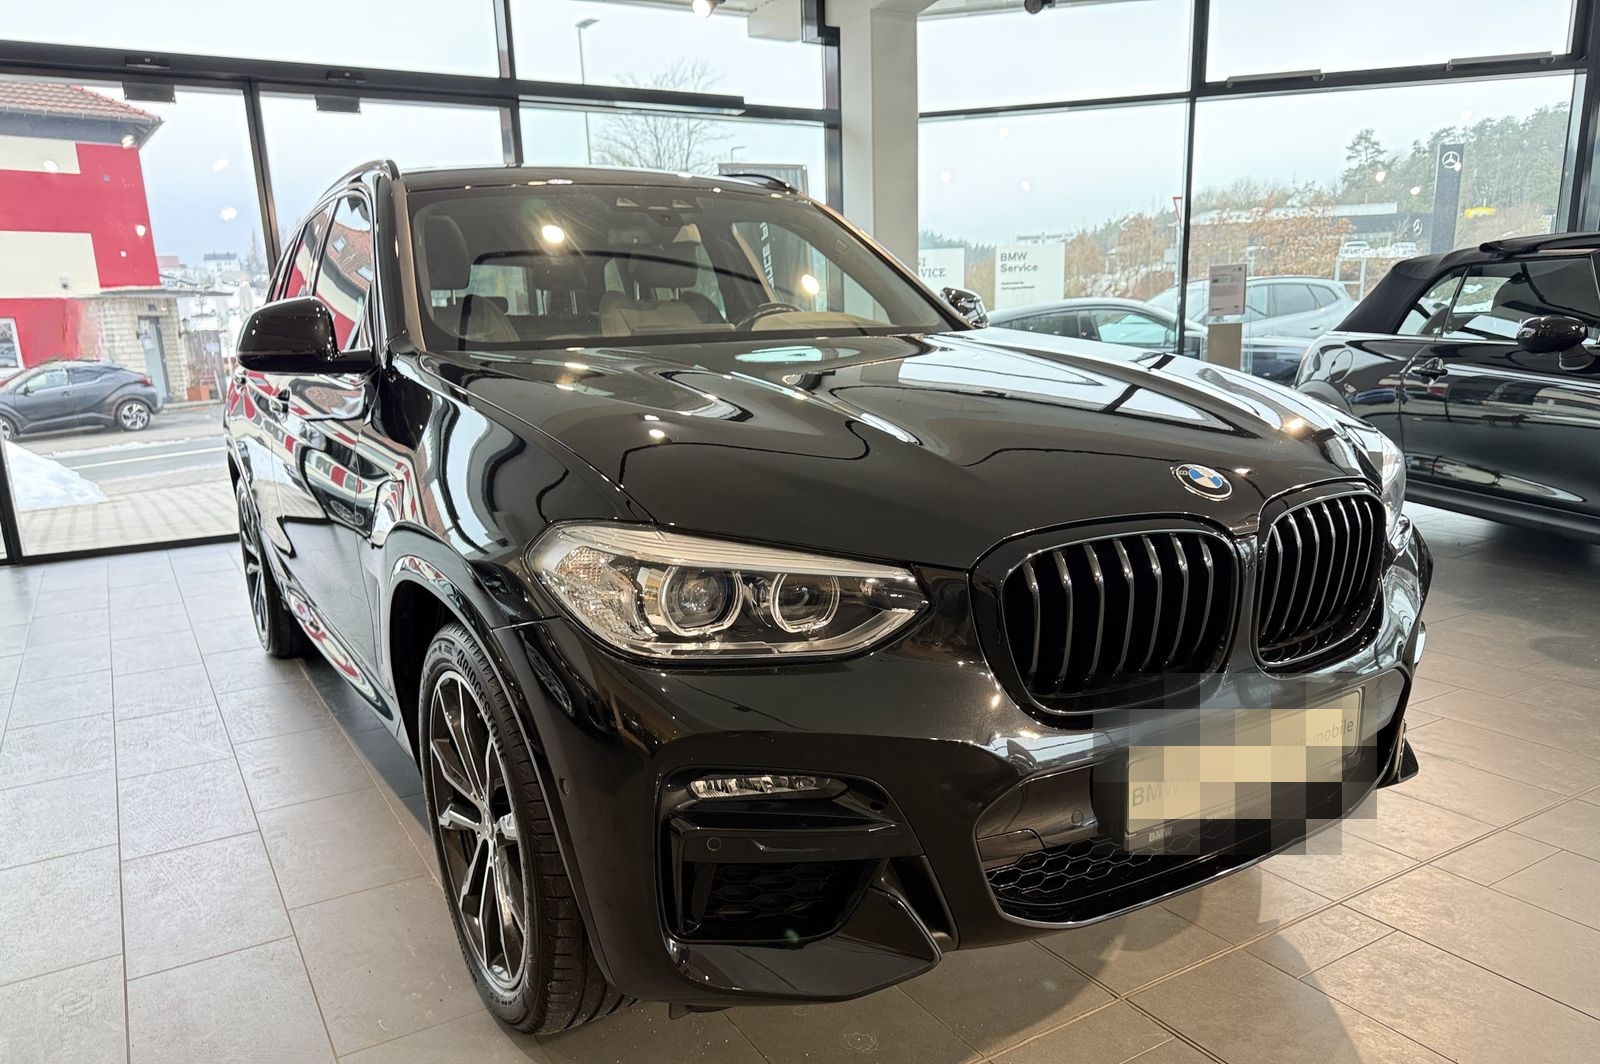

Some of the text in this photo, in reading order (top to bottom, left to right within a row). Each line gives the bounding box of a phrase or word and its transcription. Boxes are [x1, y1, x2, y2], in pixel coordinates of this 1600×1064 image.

[1000, 252, 1027, 262] BMW
[919, 268, 946, 278] VICE
[1000, 263, 1038, 273] Service
[1147, 825, 1174, 843] BMW
